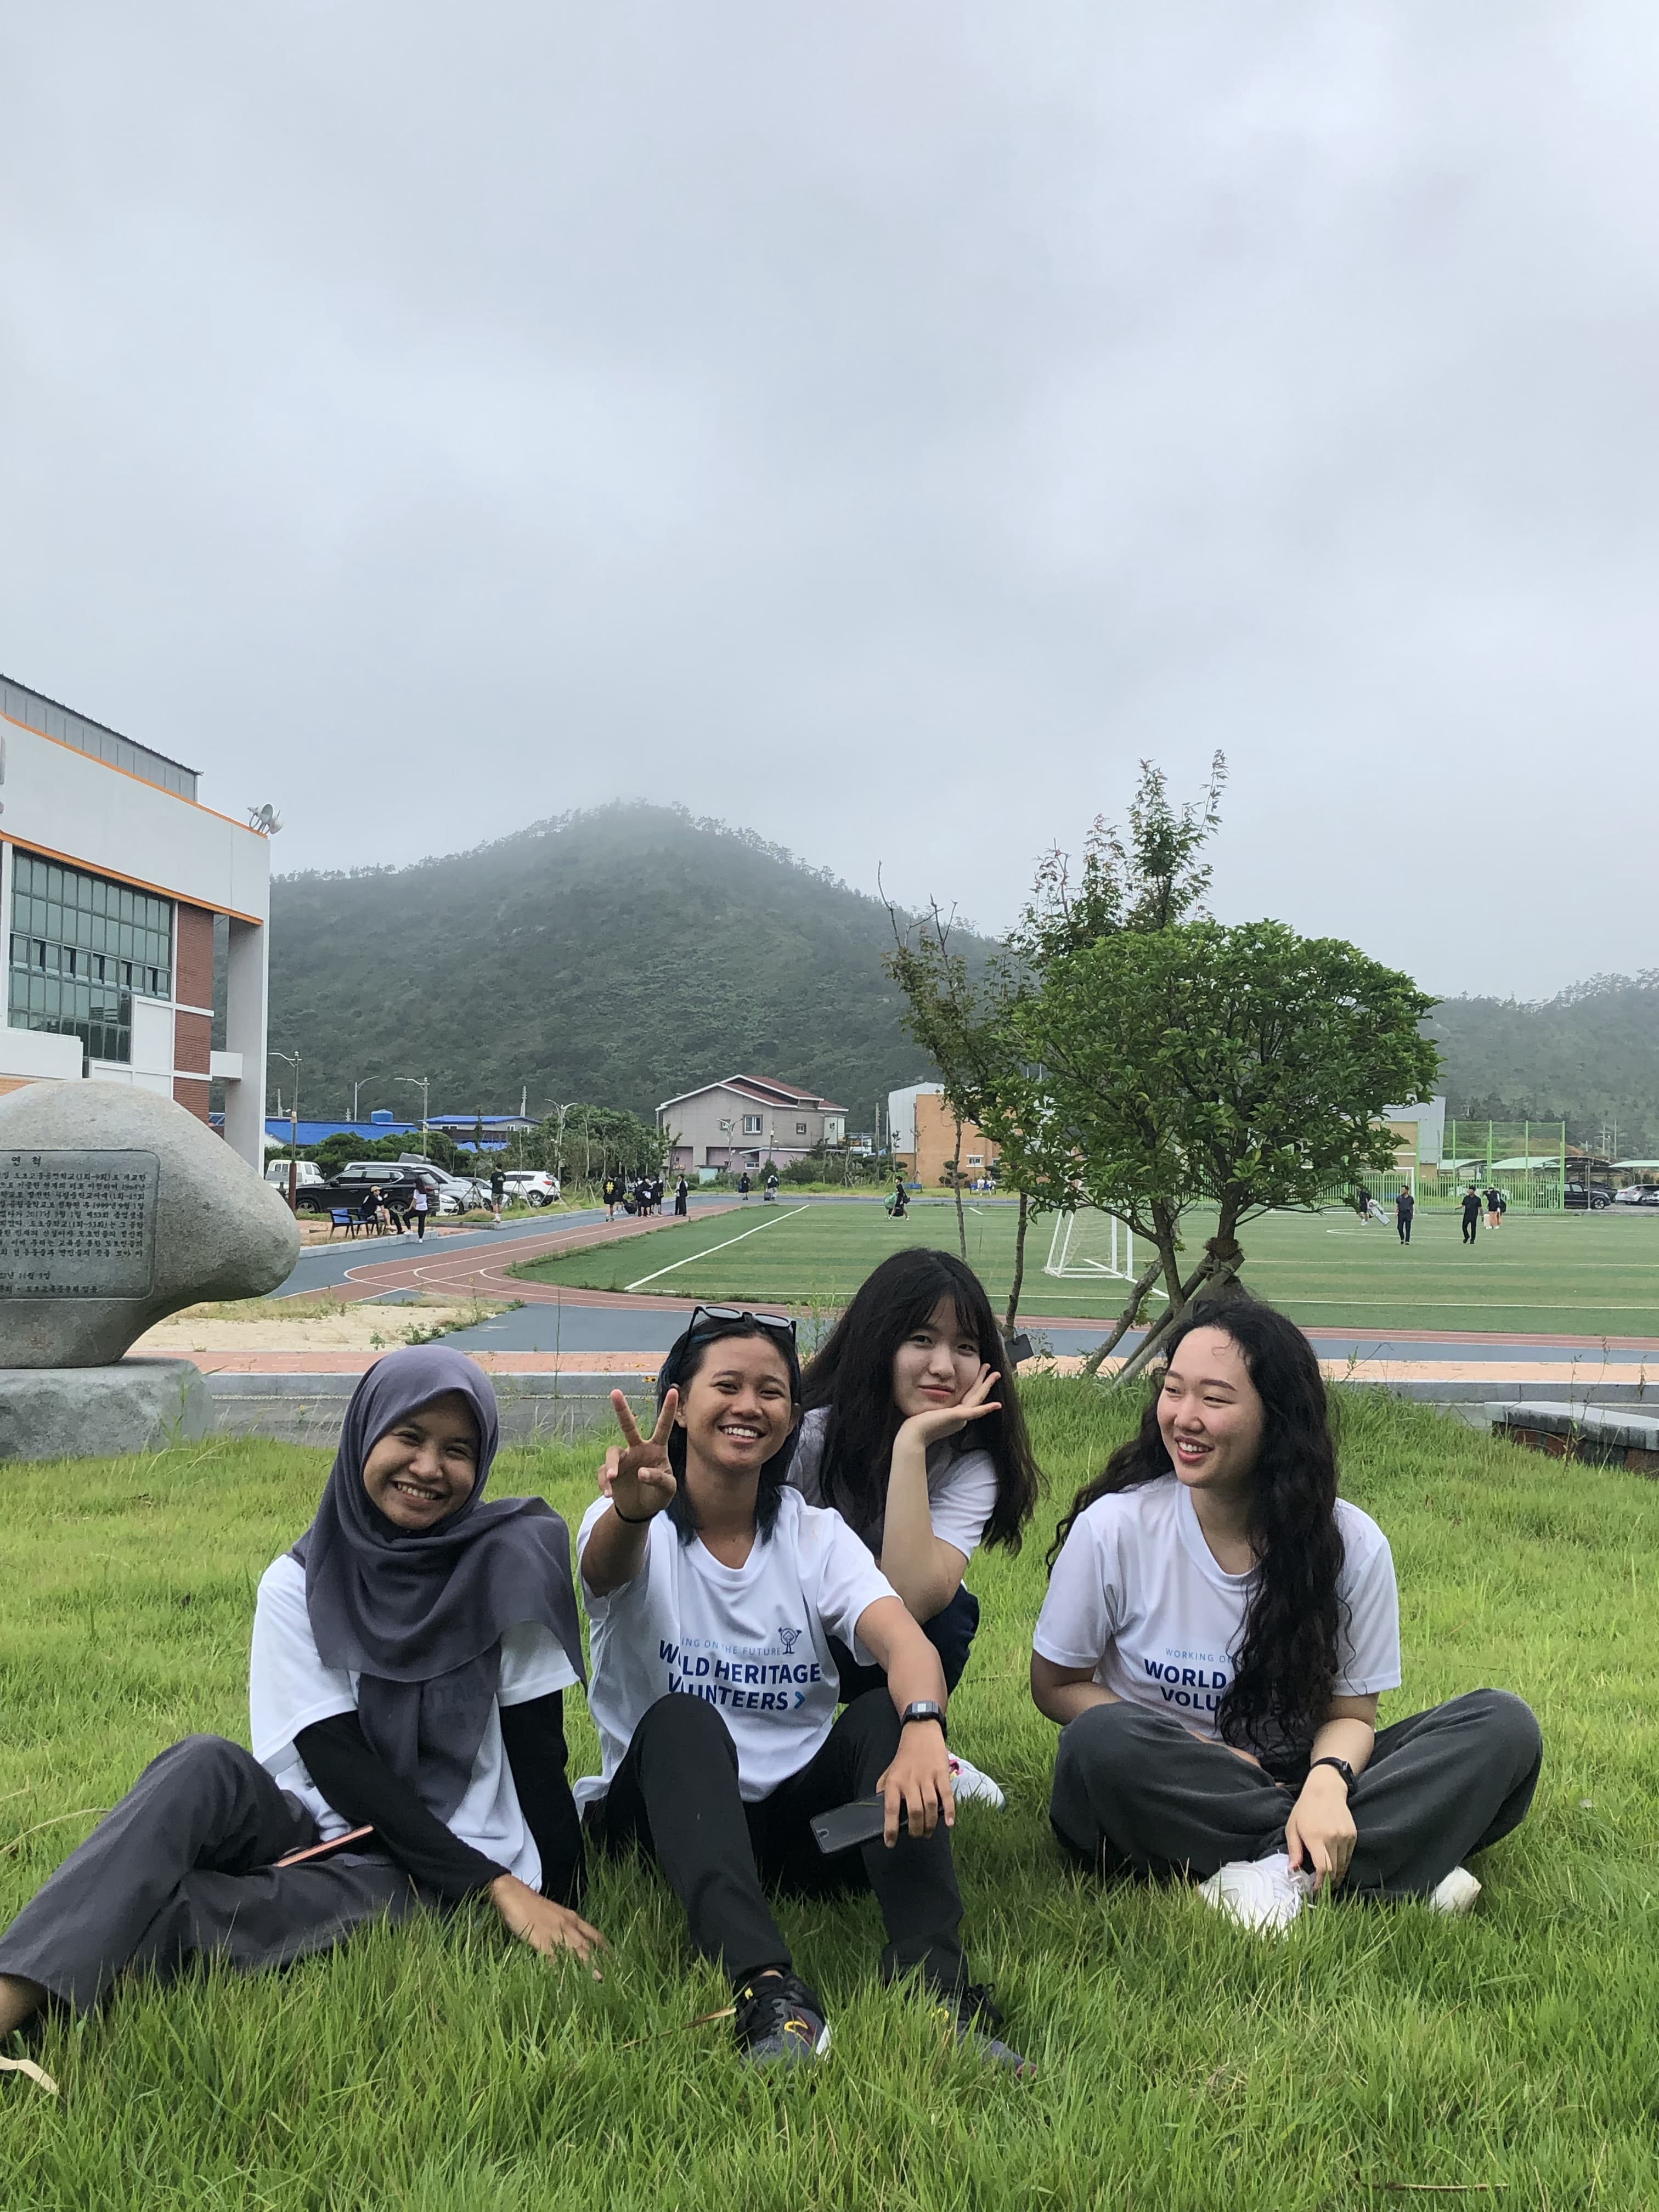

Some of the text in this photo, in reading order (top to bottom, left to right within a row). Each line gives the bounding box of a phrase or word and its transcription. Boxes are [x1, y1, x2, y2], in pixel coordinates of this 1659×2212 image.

[704, 1640, 719, 1649] ON
[722, 1644, 738, 1655] HE
[743, 1646, 781, 1656] FUTURE
[1165, 1647, 1215, 1662] WORKING
[659, 1639, 821, 1685] WLD HERITAGE
[1144, 1658, 1227, 1690] WORLD
